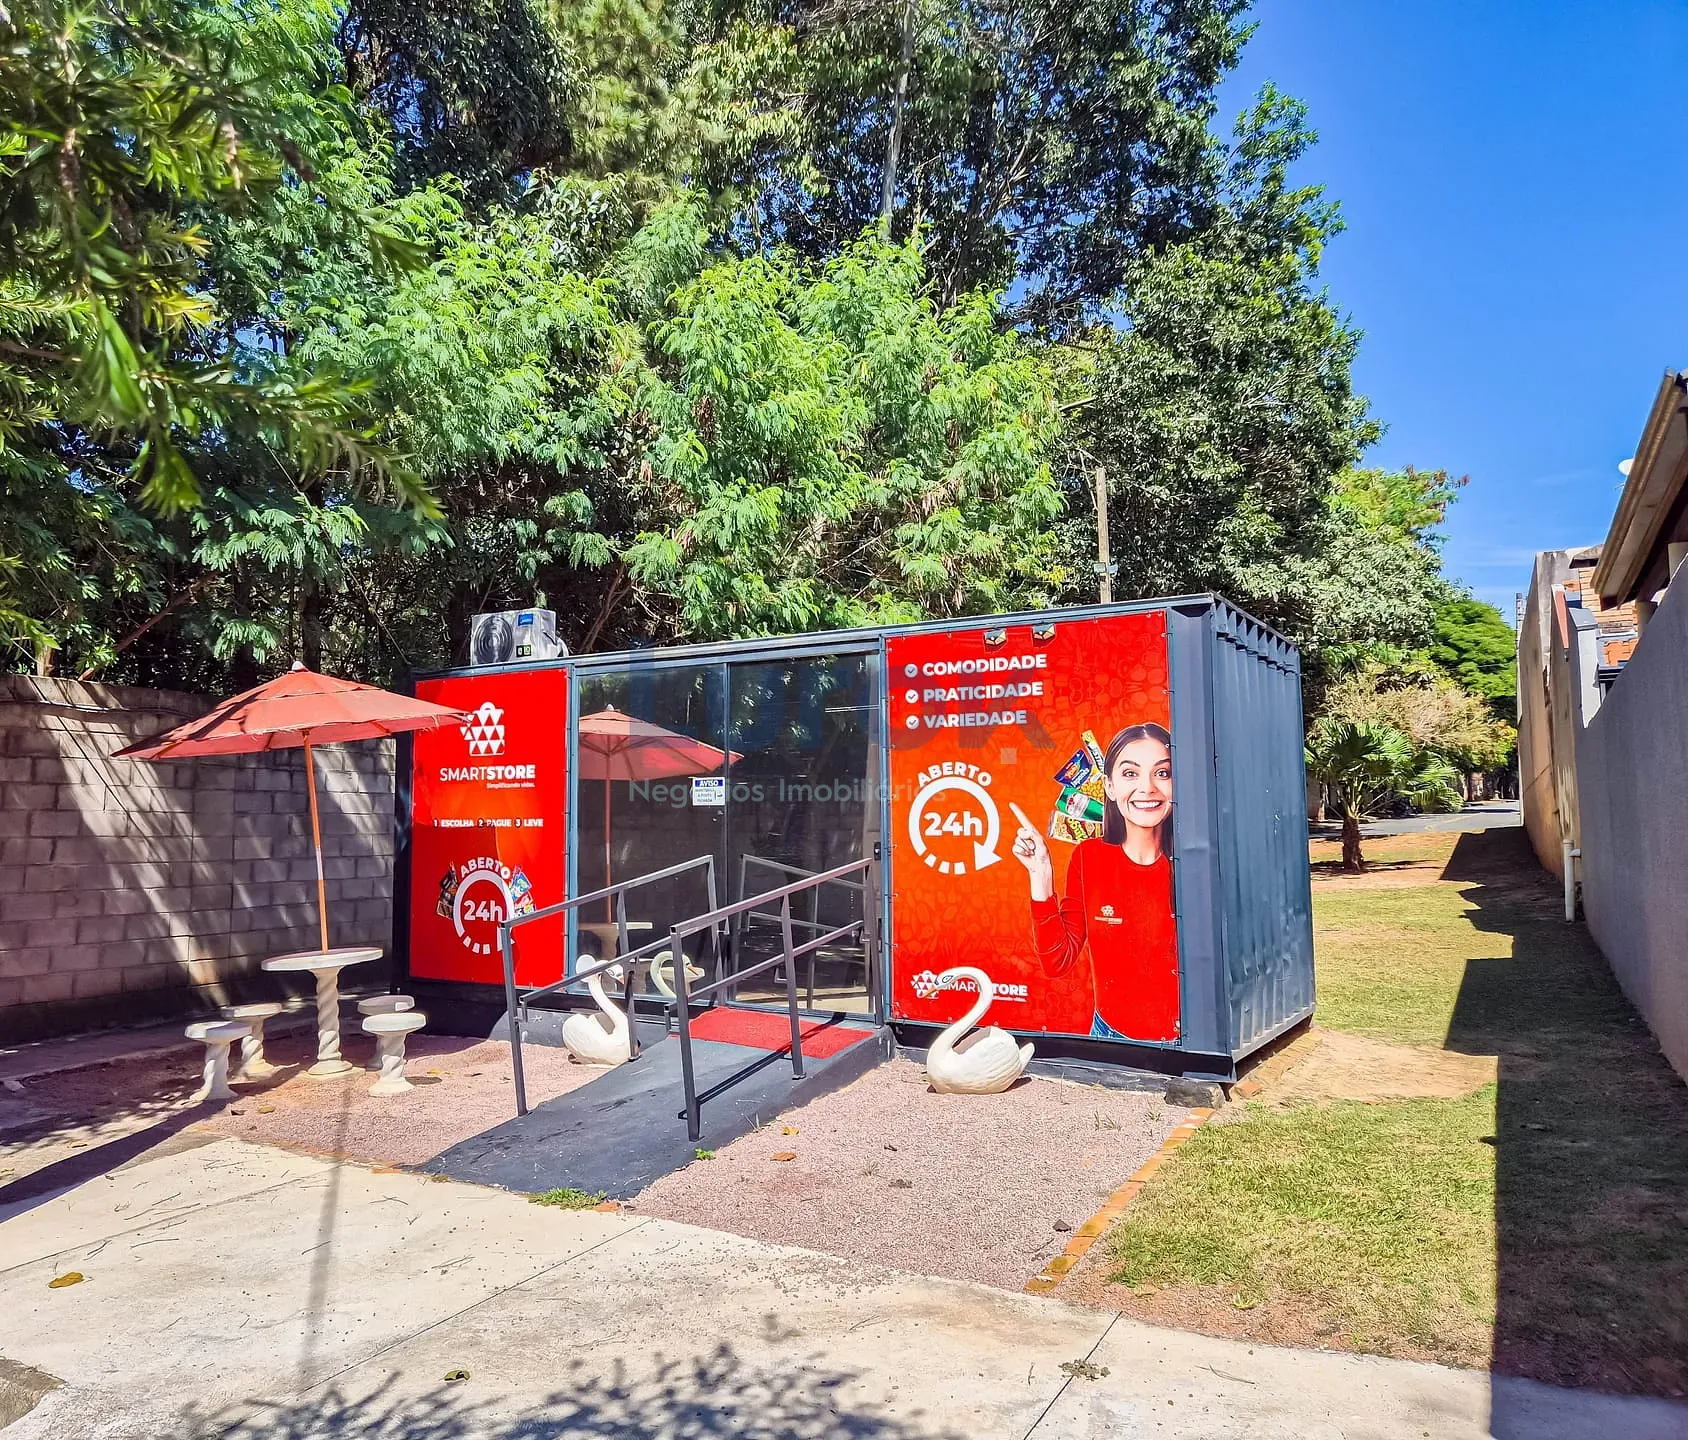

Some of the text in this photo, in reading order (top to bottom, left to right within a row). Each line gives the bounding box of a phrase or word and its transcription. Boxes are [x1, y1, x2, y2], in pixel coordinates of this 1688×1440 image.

[922, 653, 1047, 677] COMODIDADE
[923, 681, 1043, 703] PRATICIDADE
[923, 709, 1027, 729] VARIEDADE
[440, 764, 536, 782] SMARTSTORE
[918, 761, 992, 788] ABERTO
[433, 819, 544, 828] 1 ESCOLHA 2 PAGUE 3 LEVE
[924, 811, 982, 836] 24h
[460, 857, 511, 880] ABERTO
[464, 900, 503, 922] 24h
